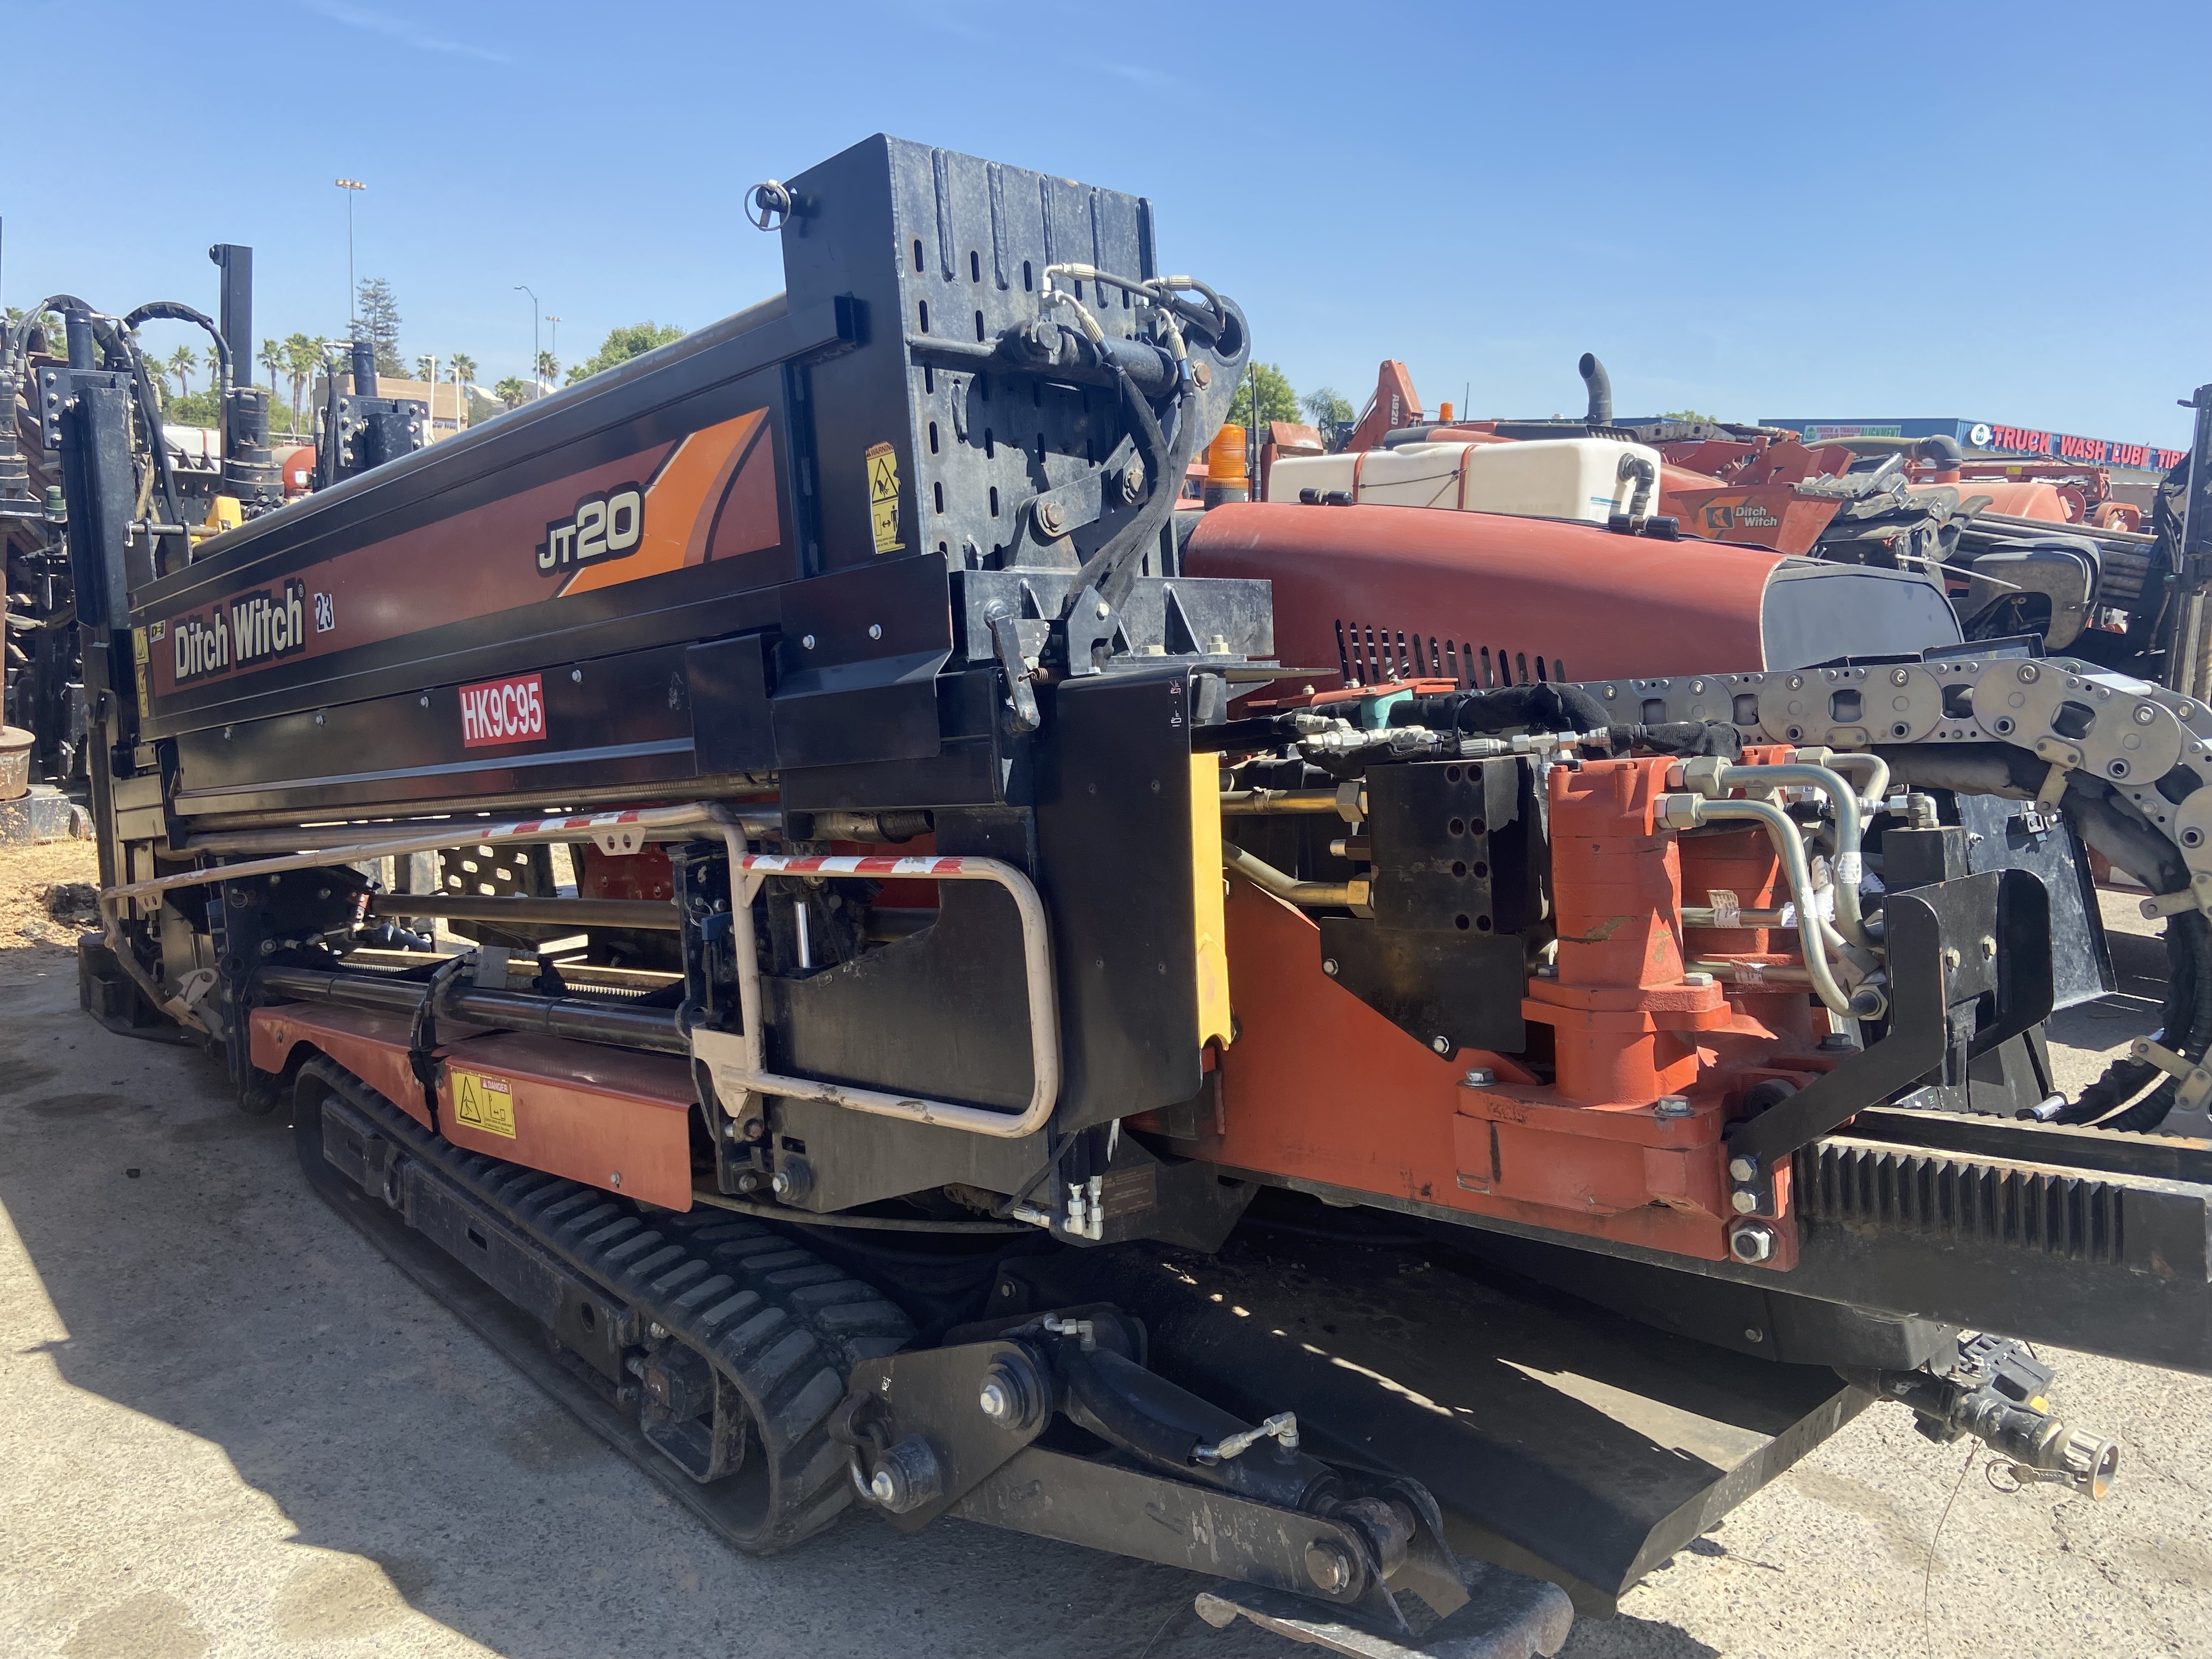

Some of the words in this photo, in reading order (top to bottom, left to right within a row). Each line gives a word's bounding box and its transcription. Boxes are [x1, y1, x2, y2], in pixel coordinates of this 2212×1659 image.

[1391, 393, 1400, 426] A920
[1976, 431, 1984, 440] 99
[1993, 425, 2052, 453] TRUCK
[2061, 435, 2106, 460] WASH
[2111, 443, 2150, 467] LUBE
[1735, 506, 1767, 517] Ditch
[1744, 516, 1778, 527] Witch
[539, 491, 640, 569] JT20
[316, 595, 332, 630] 23
[176, 613, 229, 679] Ditch
[462, 682, 541, 740] HK9C95
[488, 1080, 508, 1093] DANGER
